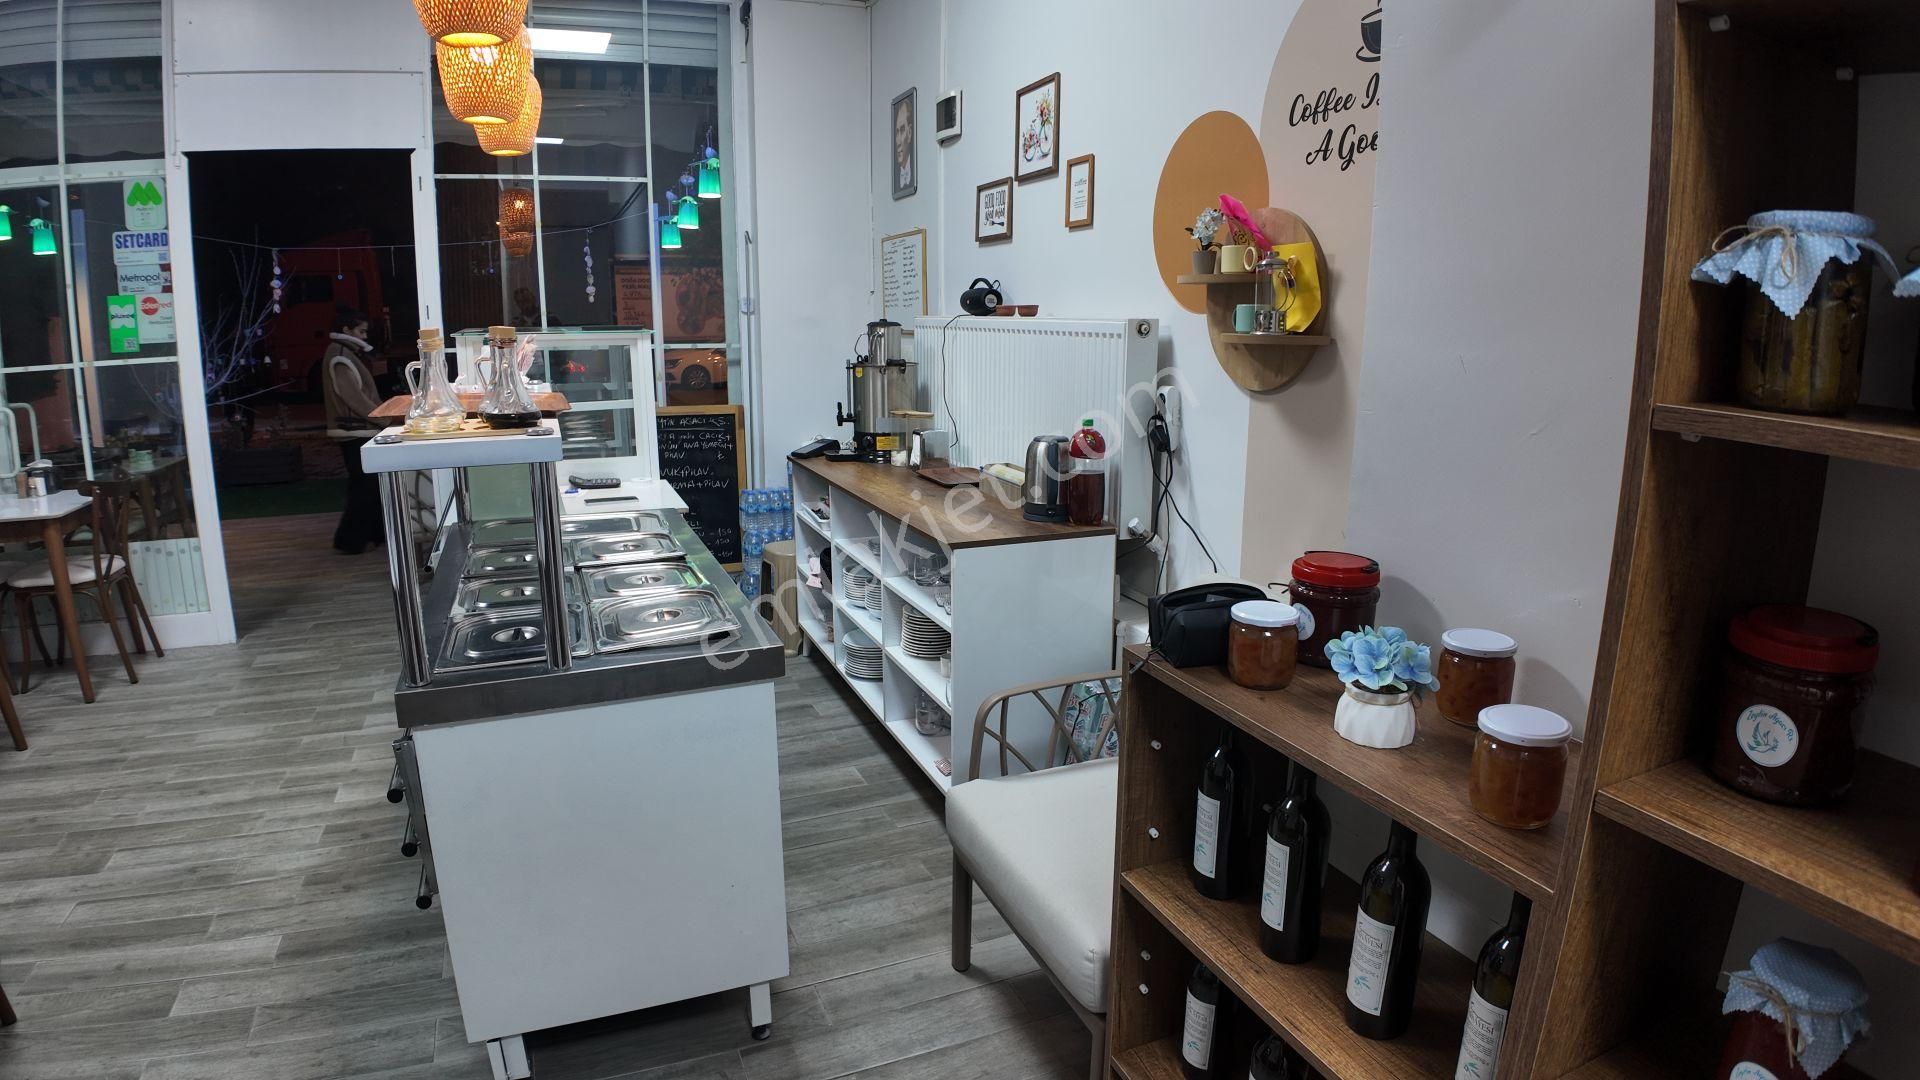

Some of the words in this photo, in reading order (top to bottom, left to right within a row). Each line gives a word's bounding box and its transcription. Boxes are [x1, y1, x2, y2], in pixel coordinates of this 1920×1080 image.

[1288, 87, 1357, 127] Coffee
[1361, 72, 1380, 110] I
[1305, 128, 1334, 165] A
[996, 189, 1006, 206] FOOD
[115, 232, 168, 249] SETCARD
[119, 272, 160, 284] Metropol
